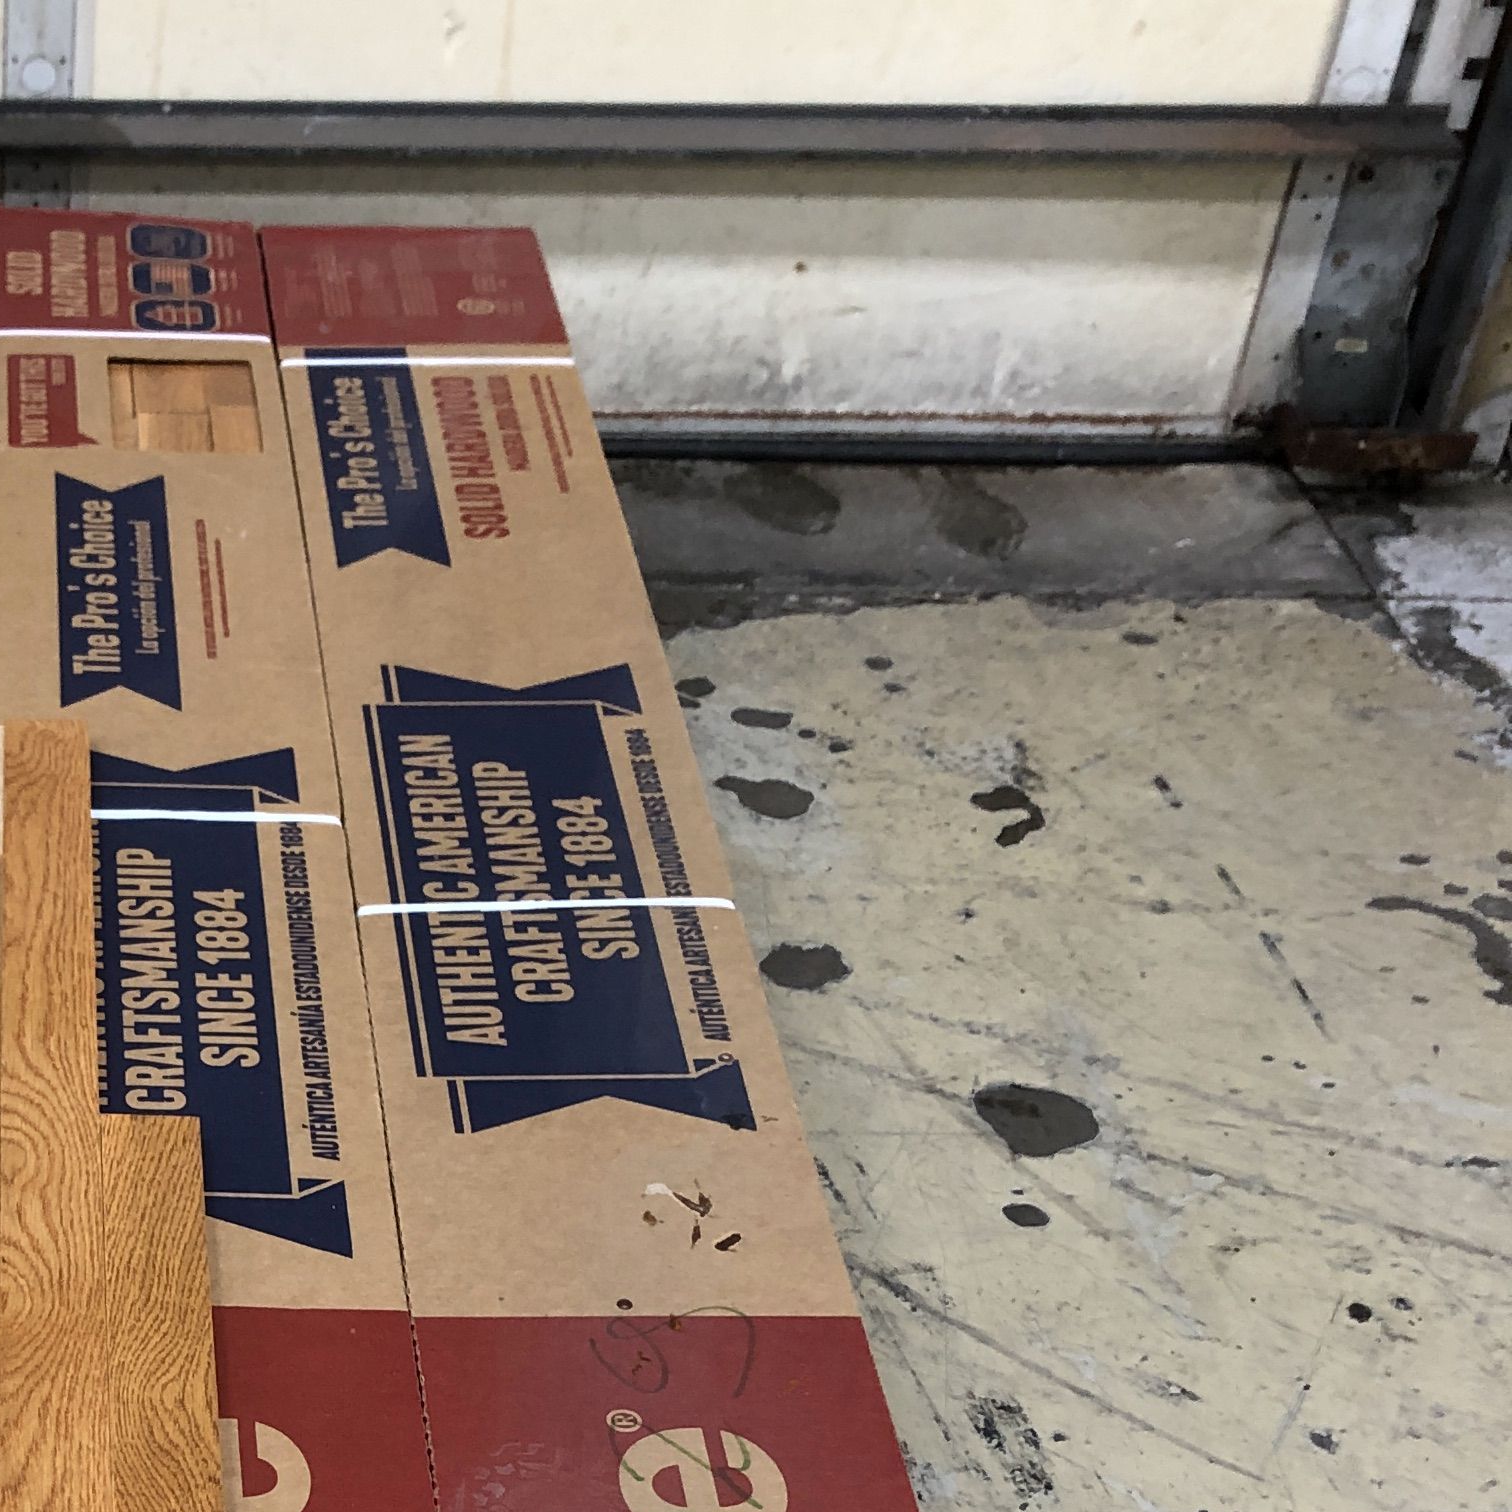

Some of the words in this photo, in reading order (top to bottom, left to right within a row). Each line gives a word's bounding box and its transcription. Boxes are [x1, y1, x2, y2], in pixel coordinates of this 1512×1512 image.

[323, 376, 372, 439] Choice
[431, 376, 496, 478] HARDWOOD
[329, 440, 382, 491] Pro's
[68, 499, 117, 569] Choice
[342, 492, 388, 530] The
[454, 483, 510, 539] SOLID
[67, 573, 119, 630] Pro's
[72, 633, 122, 675] The
[398, 734, 476, 876] AMERICAN
[553, 795, 617, 867] 1884
[280, 851, 309, 889] DESDE
[471, 760, 575, 1003] CRAFTSMANSHIP
[193, 888, 252, 966] 1884
[285, 897, 324, 1002] ESTADOUNIDENSE
[568, 873, 639, 960] SINCE
[115, 848, 187, 1111] CRAFTSMANSHIP
[422, 881, 507, 1046] AUTHENTC
[195, 972, 261, 1068] SINCE
[291, 1003, 332, 1082] ARTESANÍA
[688, 968, 732, 1041] AUTÉNTICA
[301, 1083, 341, 1162] AUTÉNTICA
